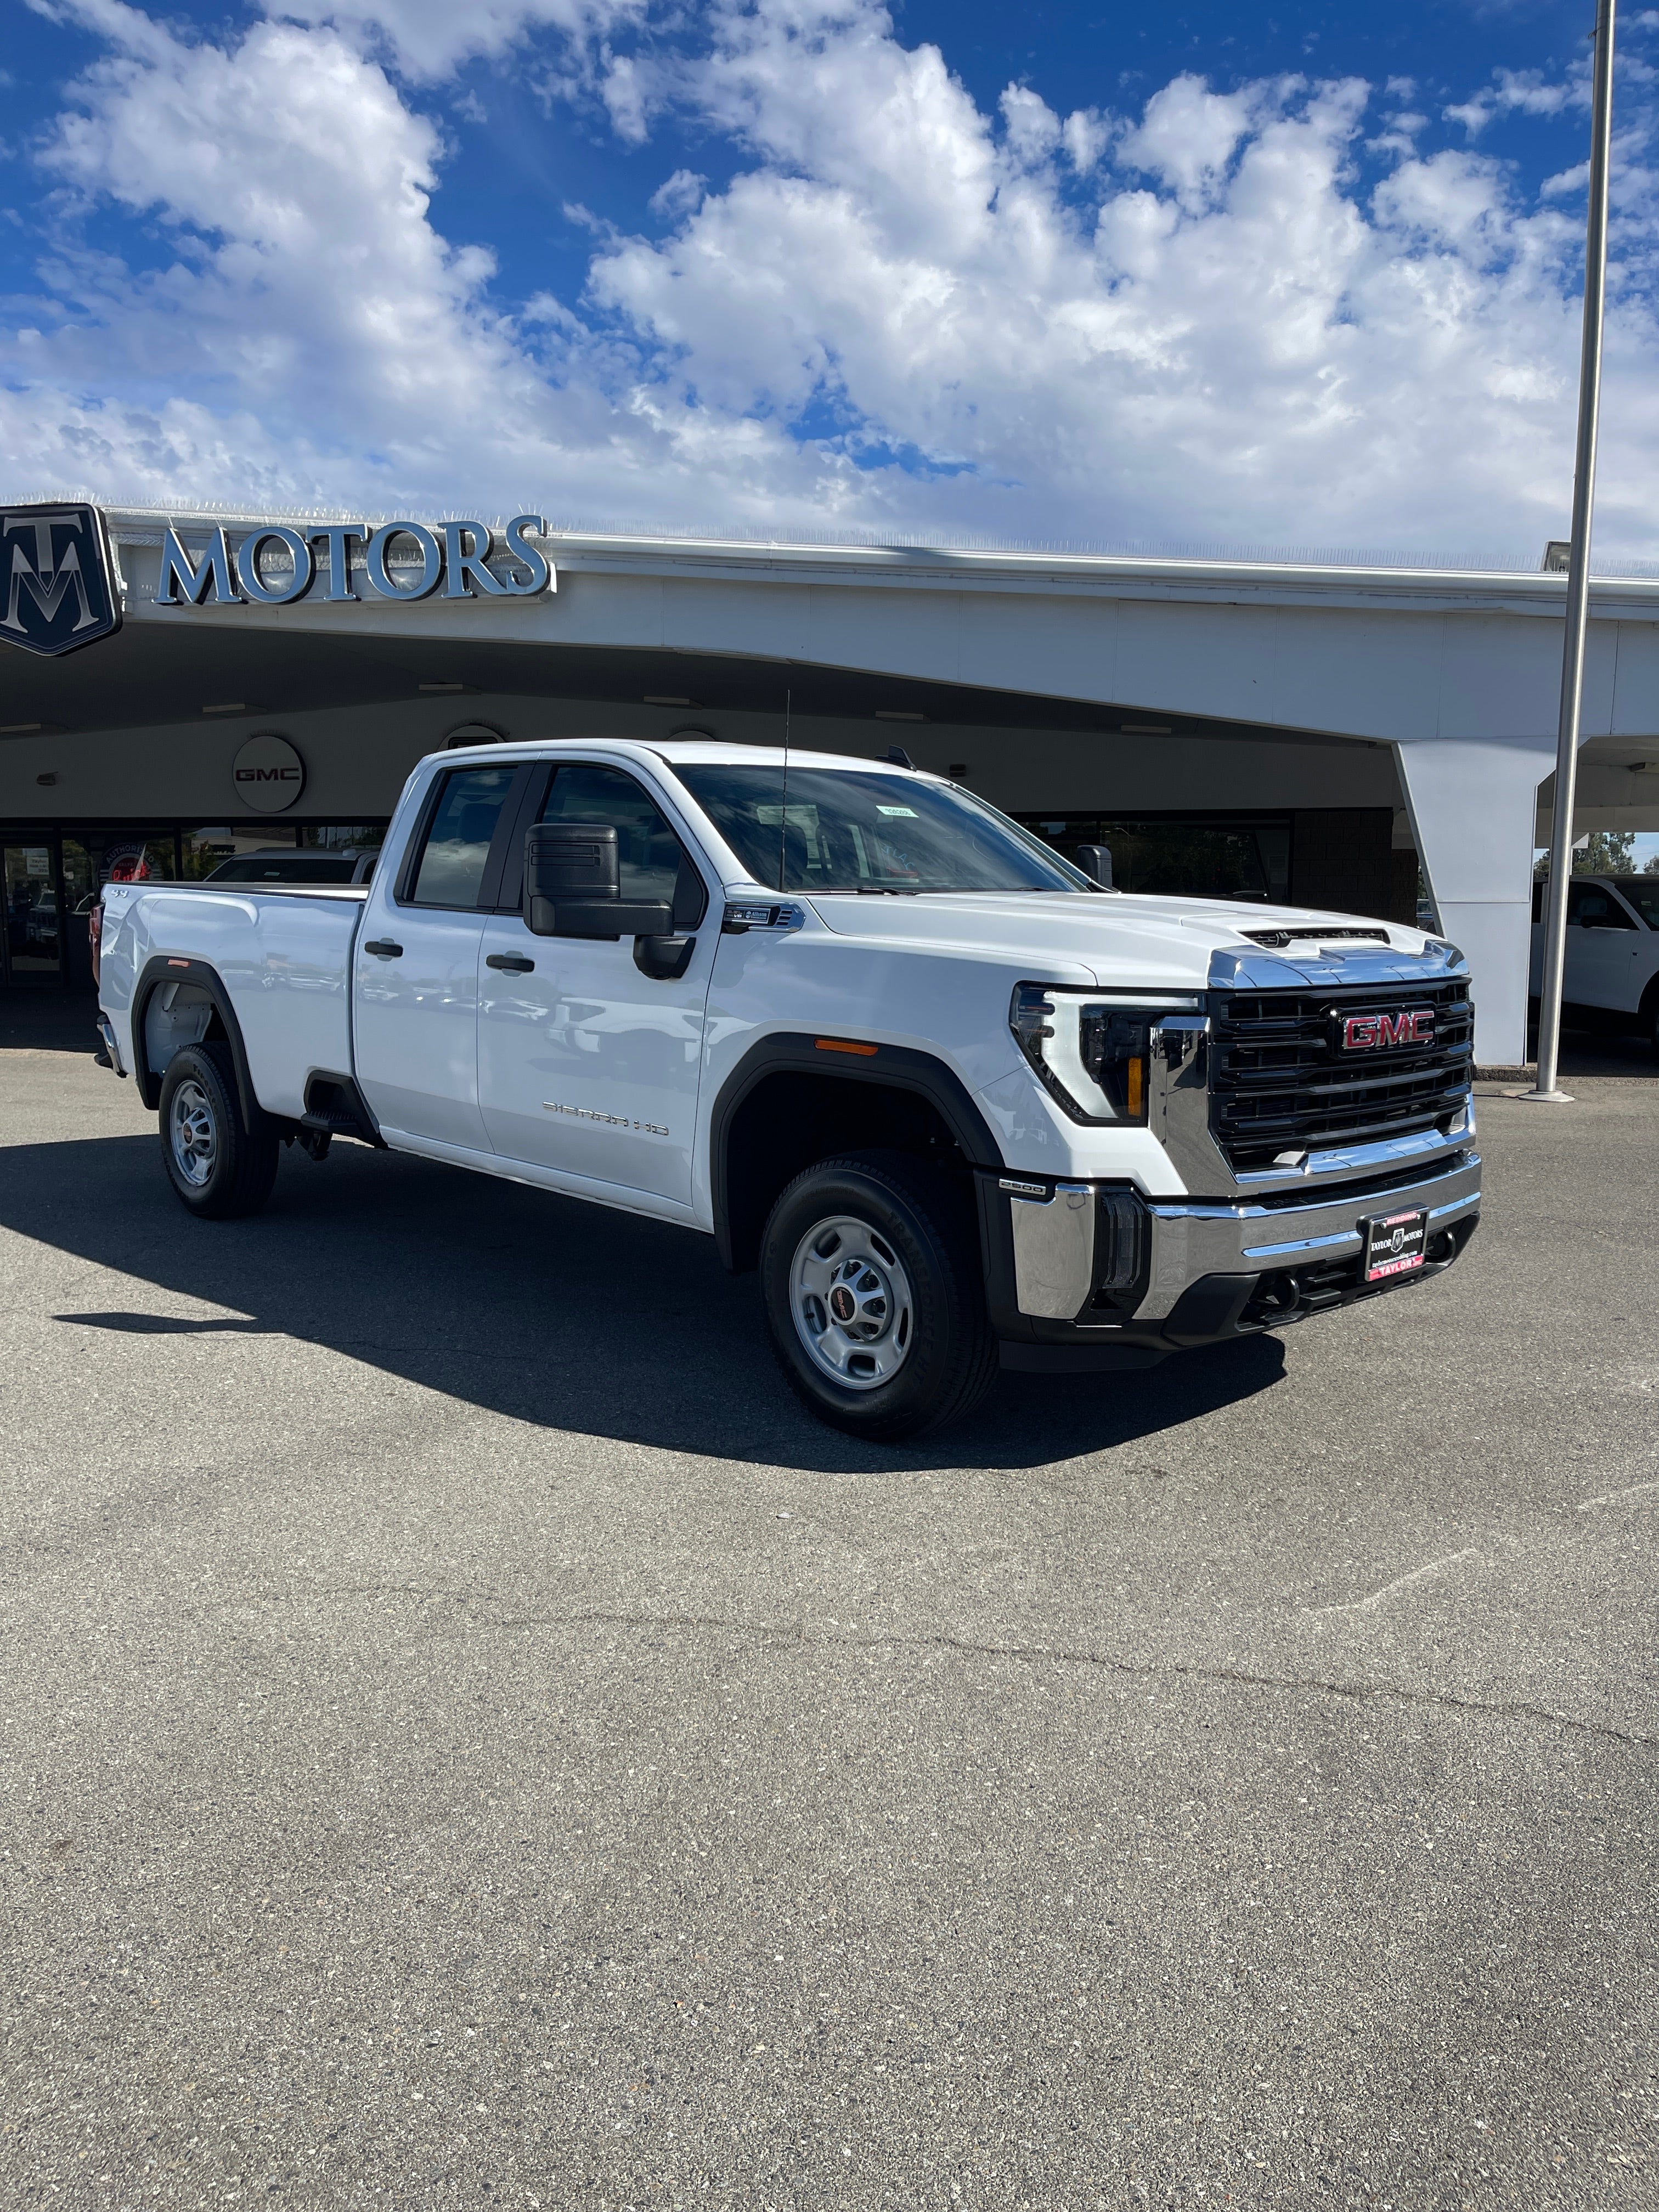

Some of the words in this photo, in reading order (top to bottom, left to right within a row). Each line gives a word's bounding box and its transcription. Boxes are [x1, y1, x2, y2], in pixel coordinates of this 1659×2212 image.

[152, 514, 549, 605] MOTORS
[235, 766, 302, 782] GMC
[1342, 1010, 1435, 1049] GMC
[542, 1101, 629, 1127] SIERRA
[633, 1120, 669, 1136] HD
[1001, 1182, 1043, 1192] 2500
[1387, 1212, 1417, 1225] REDDING
[1370, 1238, 1392, 1251] TAYLOR
[1403, 1229, 1424, 1243] MOTORS
[1379, 1259, 1413, 1276] TAYLOR
[836, 1289, 848, 1319] GMC
